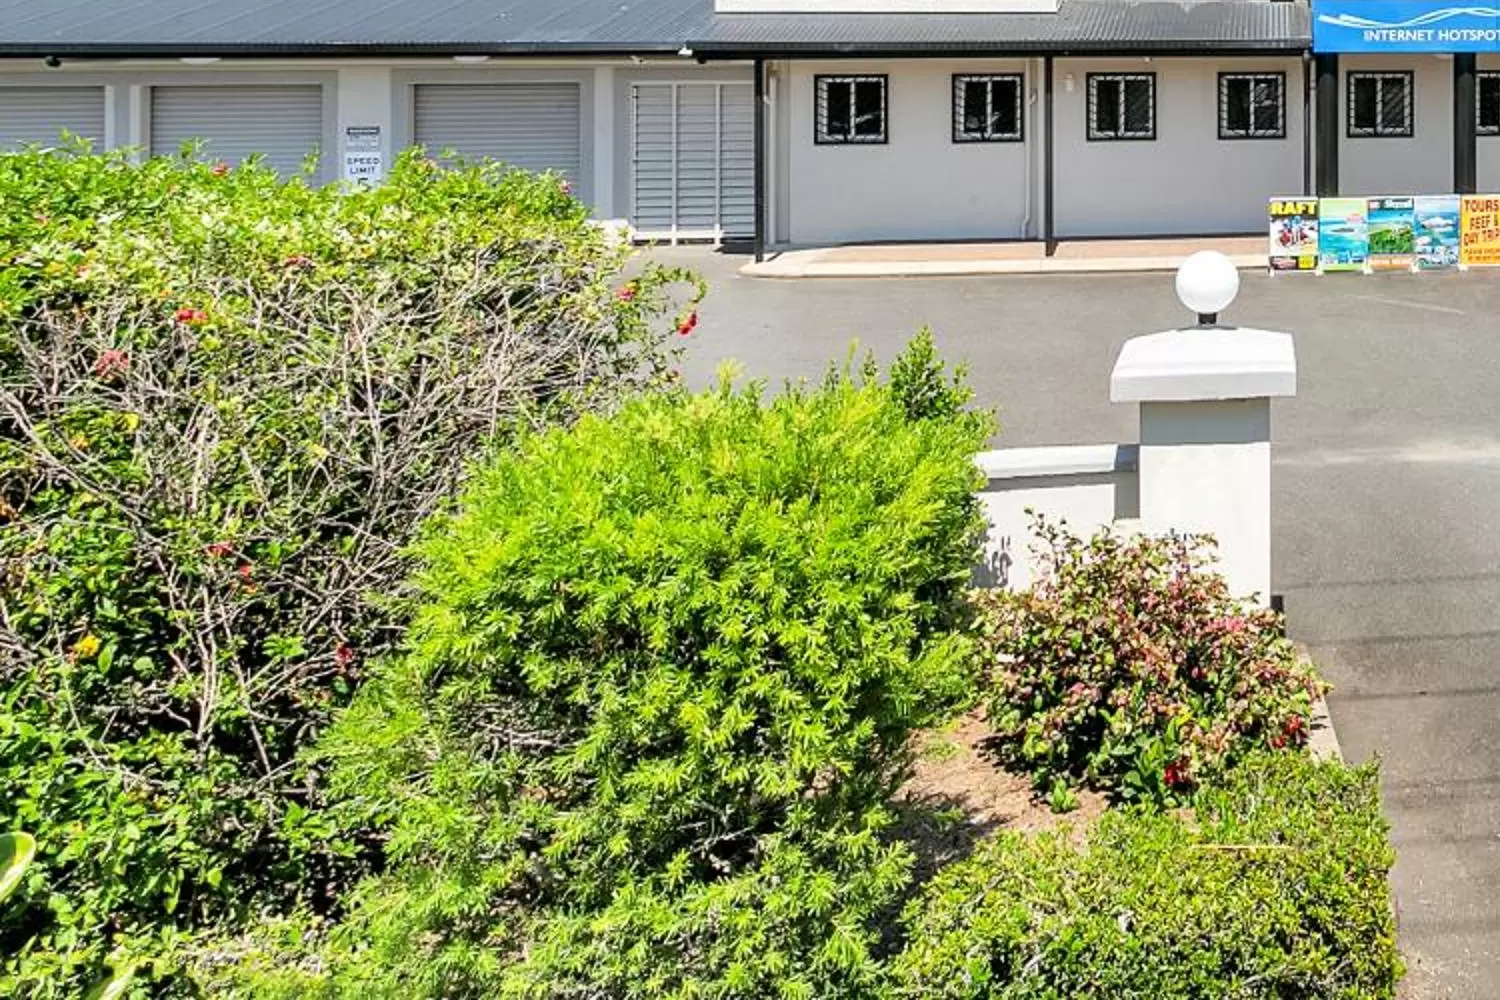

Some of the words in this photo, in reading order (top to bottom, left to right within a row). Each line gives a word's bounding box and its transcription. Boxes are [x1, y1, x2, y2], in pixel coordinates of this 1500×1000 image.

[1363, 29, 1433, 42] INTERNET
[347, 157, 380, 165] SPEED
[350, 167, 375, 175] LIMIT
[1269, 201, 1317, 215] RAFT
